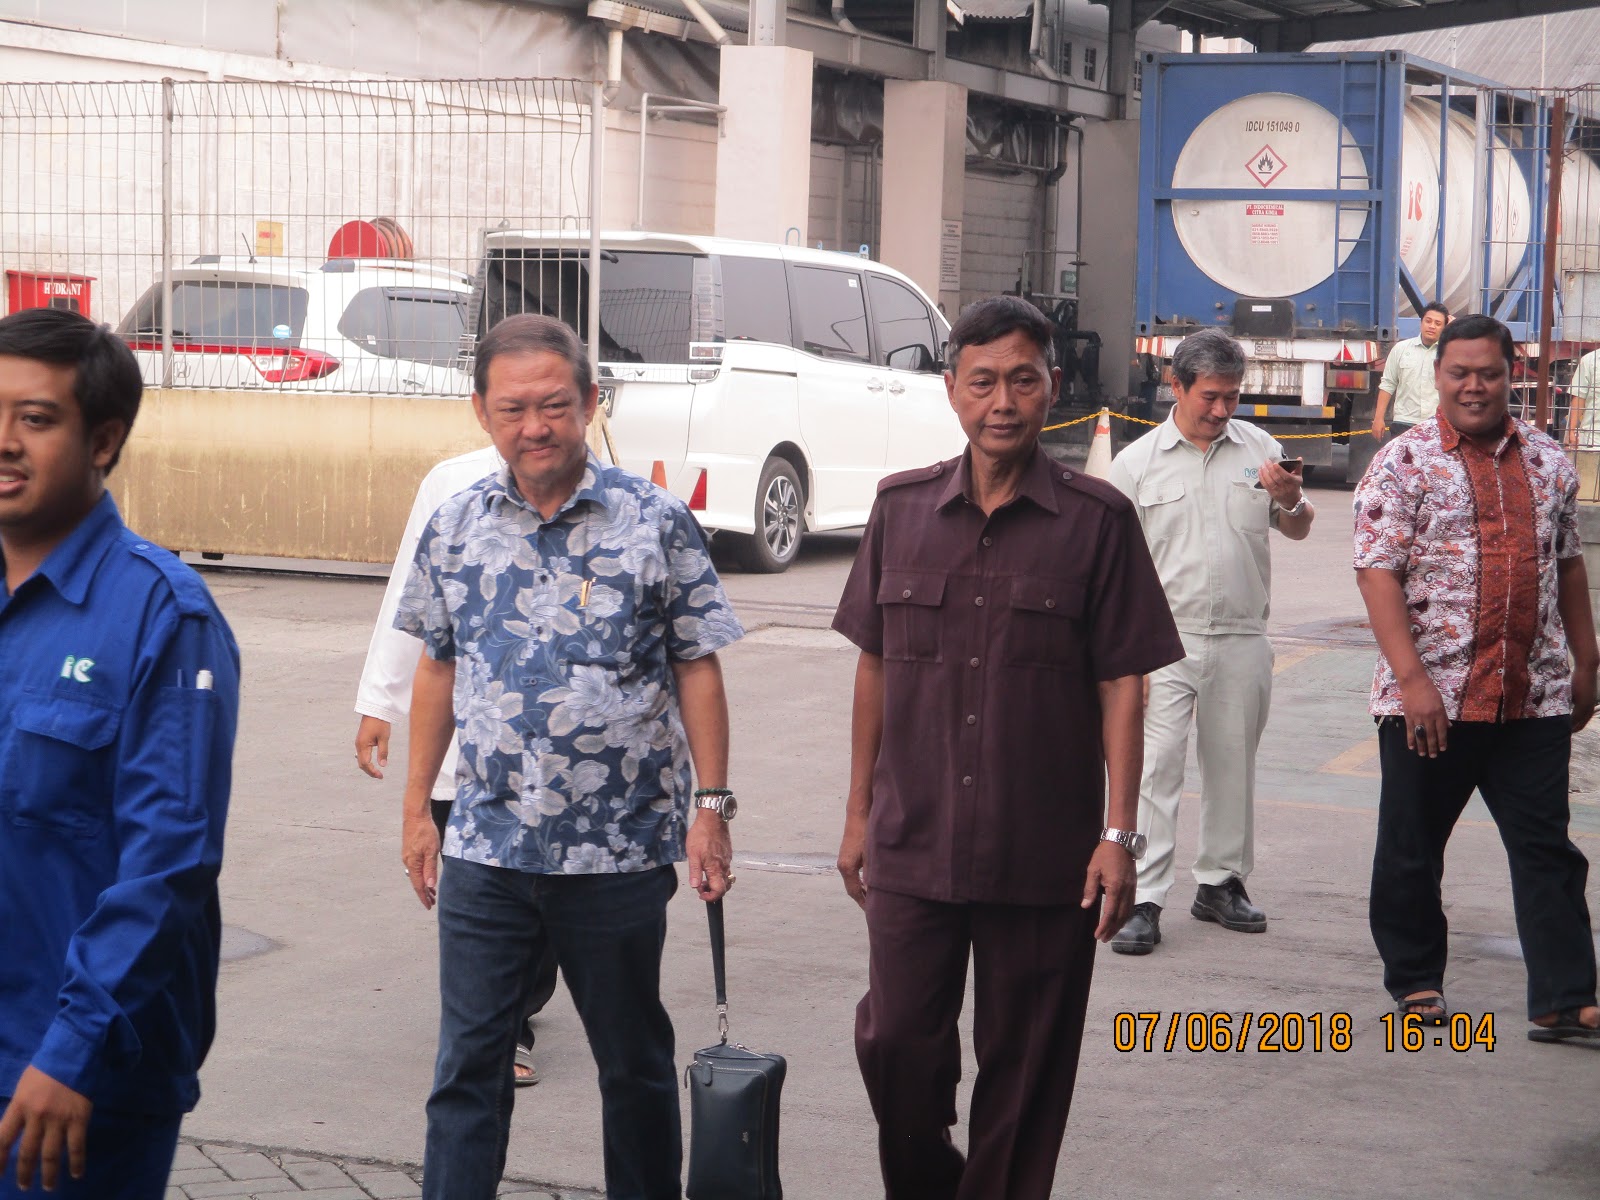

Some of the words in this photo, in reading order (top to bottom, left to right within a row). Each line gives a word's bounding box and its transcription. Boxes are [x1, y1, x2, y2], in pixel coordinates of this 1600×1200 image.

[1245, 121, 1265, 132] IDCU
[1266, 121, 1293, 132] 151049
[1294, 121, 1300, 133] 0
[44, 282, 82, 296] HYDRANT
